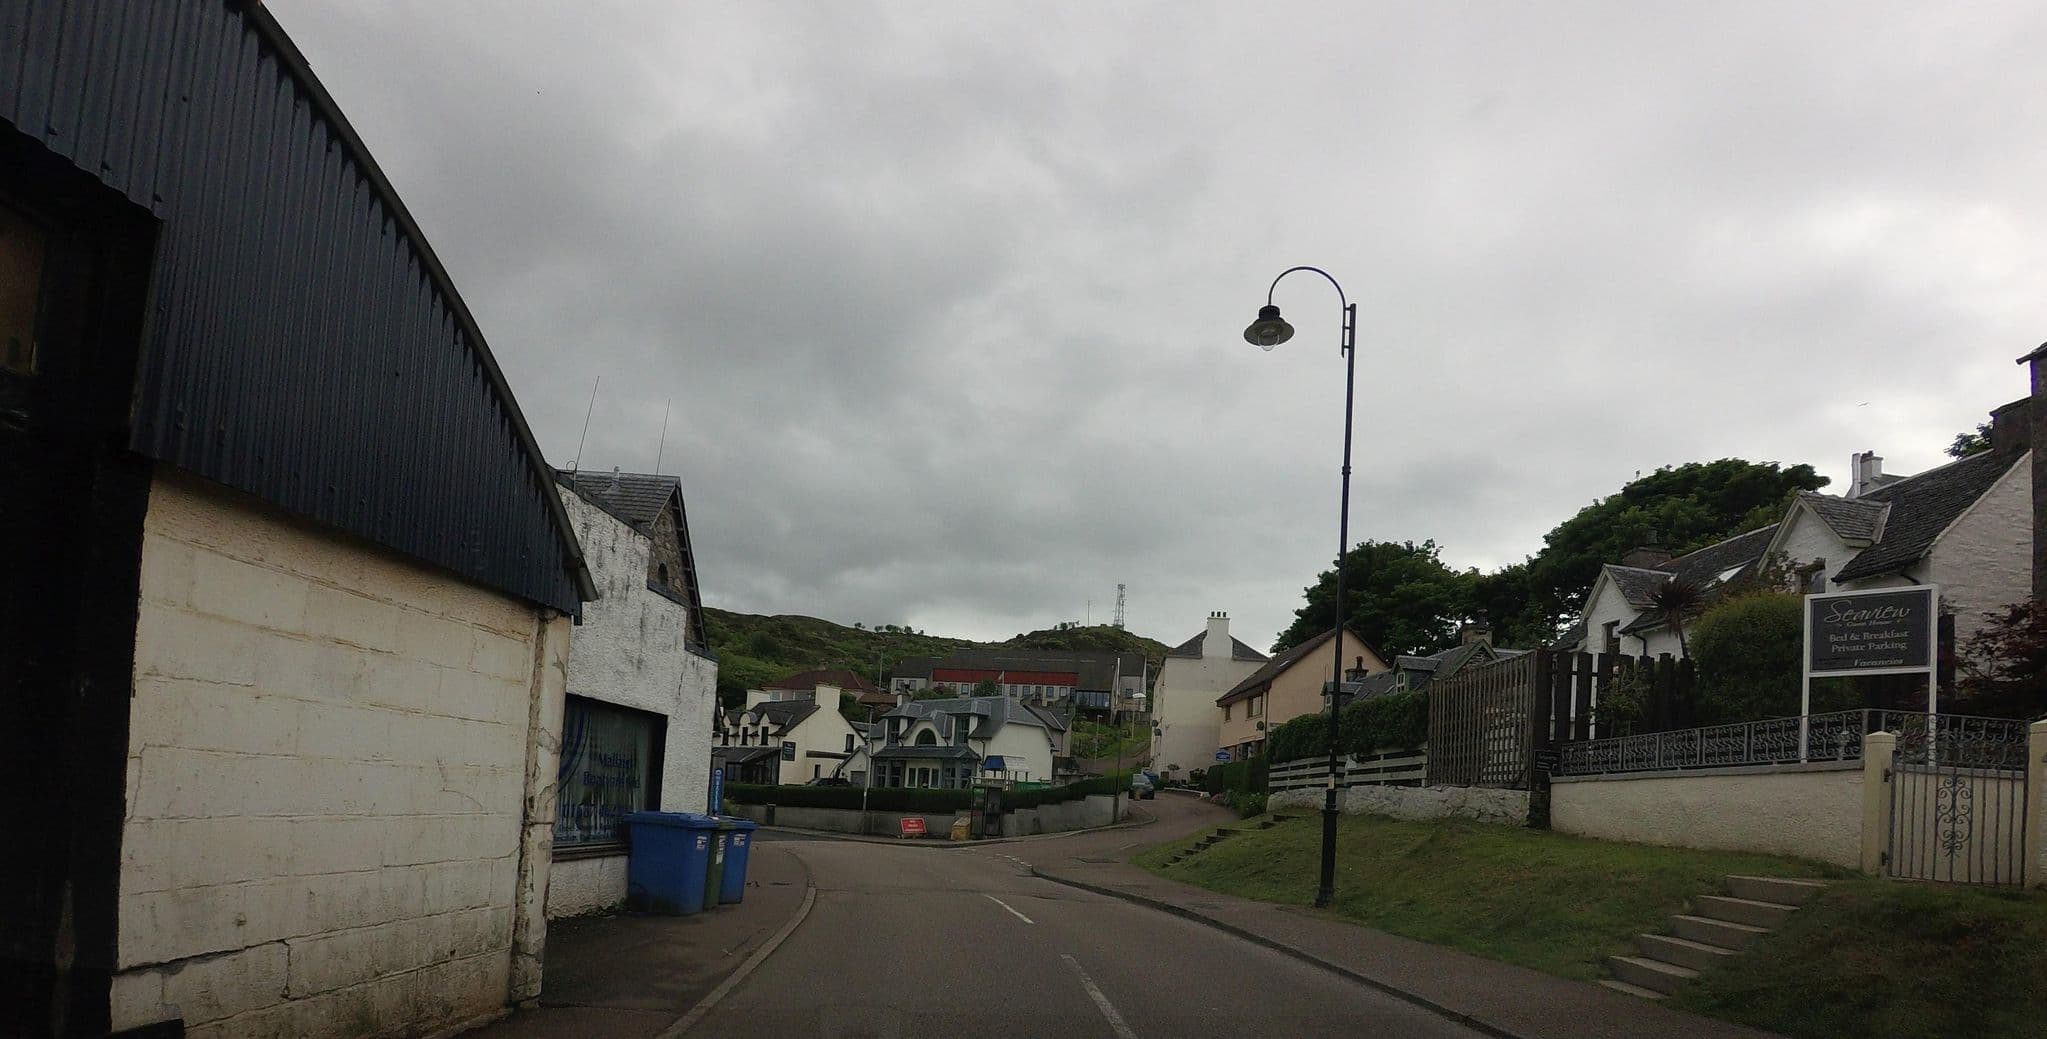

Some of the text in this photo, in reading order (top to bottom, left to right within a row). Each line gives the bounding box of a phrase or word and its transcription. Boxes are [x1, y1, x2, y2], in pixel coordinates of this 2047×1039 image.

[1824, 599, 1911, 623] Seaview
[1829, 629, 1910, 643] Bed & Breakfast
[1831, 641, 1907, 653] Private Parking
